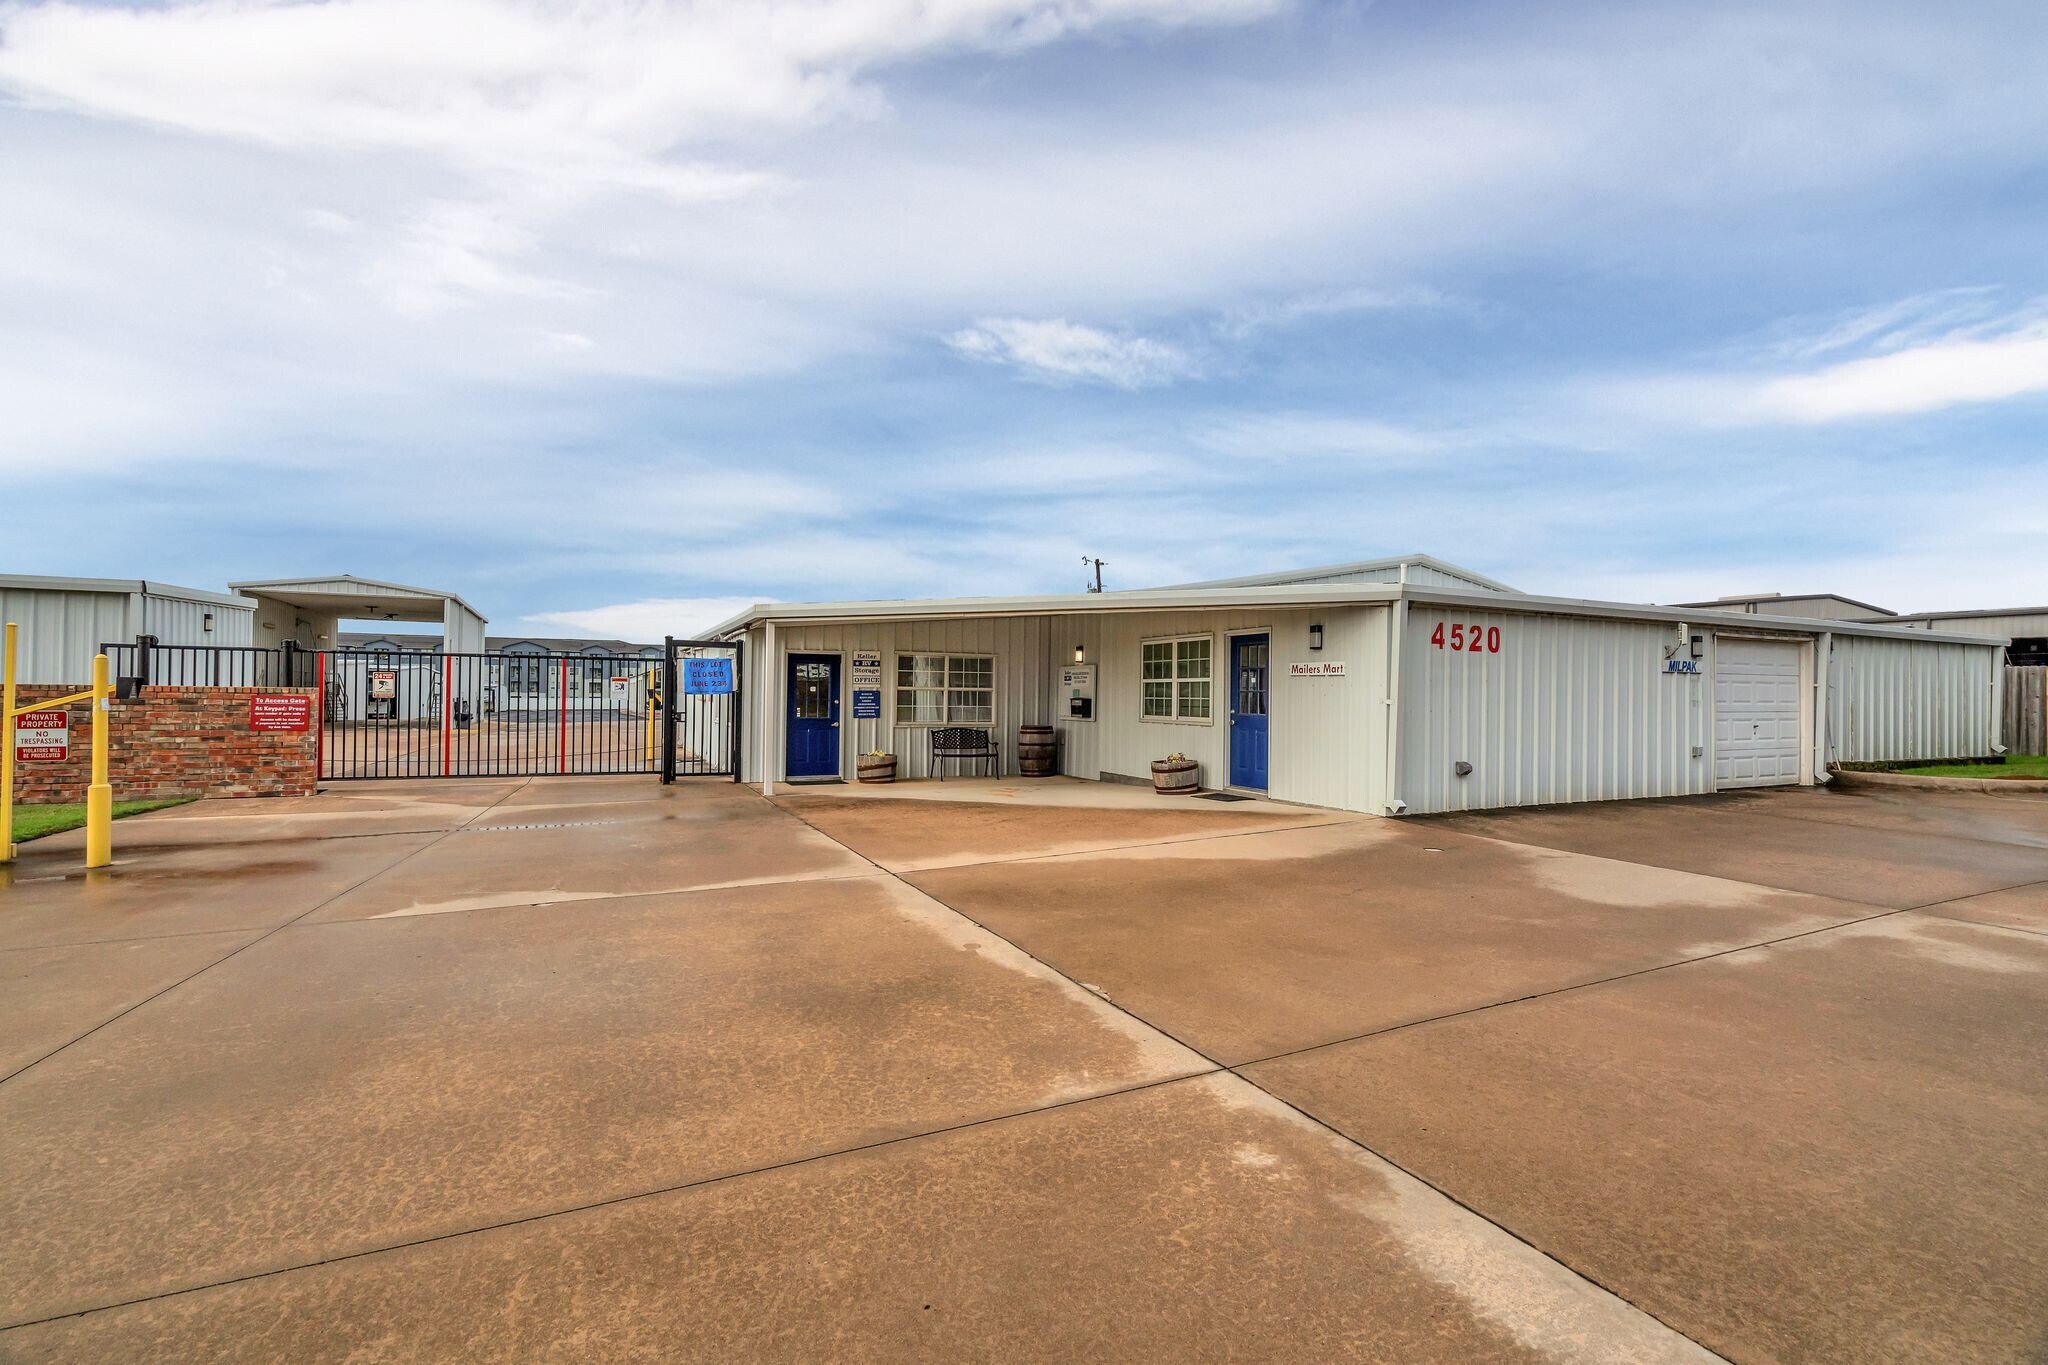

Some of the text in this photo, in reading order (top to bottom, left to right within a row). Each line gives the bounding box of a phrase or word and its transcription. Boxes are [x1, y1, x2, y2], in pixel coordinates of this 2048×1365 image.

[1431, 622, 1500, 653] 4520
[689, 661, 705, 669] THIS
[1291, 663, 1344, 674] Mailers Mart
[1668, 660, 1697, 673] MILPAK
[854, 667, 879, 675] Storage
[25, 713, 59, 721] PRIVATE
[21, 720, 63, 728] PROPERTY
[35, 730, 49, 738] NO
[20, 737, 64, 745] TRESPASSING
